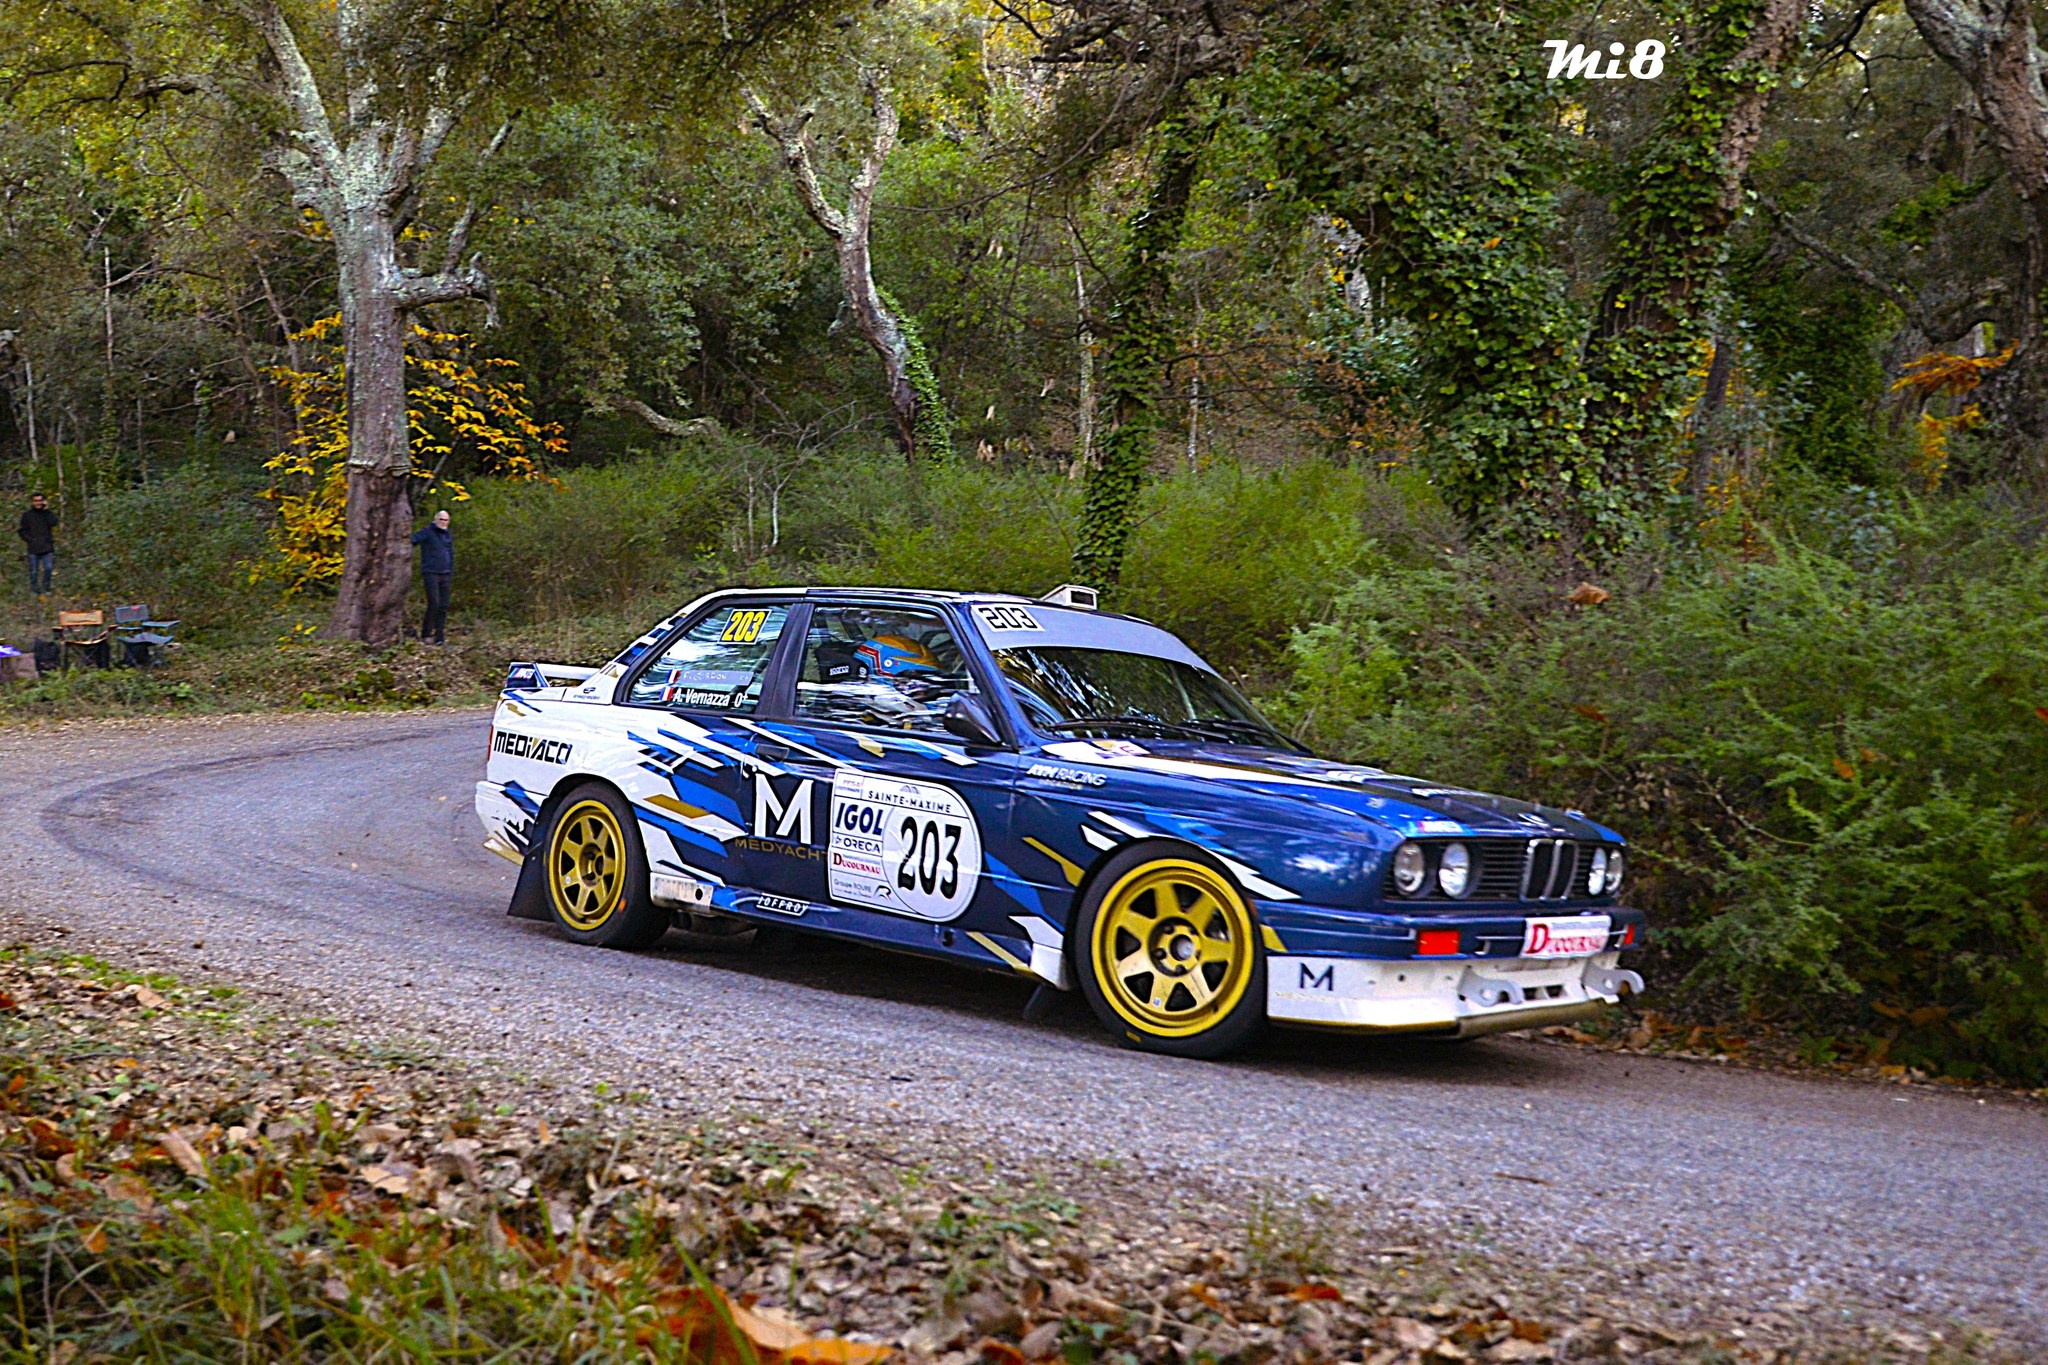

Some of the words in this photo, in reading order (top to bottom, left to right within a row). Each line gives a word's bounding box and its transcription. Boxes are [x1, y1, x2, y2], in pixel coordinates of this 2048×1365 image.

[721, 611, 766, 642] 203
[978, 607, 1038, 629] 203
[673, 688, 683, 703] A.
[686, 689, 731, 707] Vernazza
[1057, 768, 1107, 786] RACING
[754, 773, 814, 845] M
[868, 790, 952, 813] SAINTE-MAXIME
[835, 802, 883, 836] IGOL
[843, 837, 881, 854] ORECA
[897, 816, 962, 899] 203
[1300, 962, 1333, 992] M
